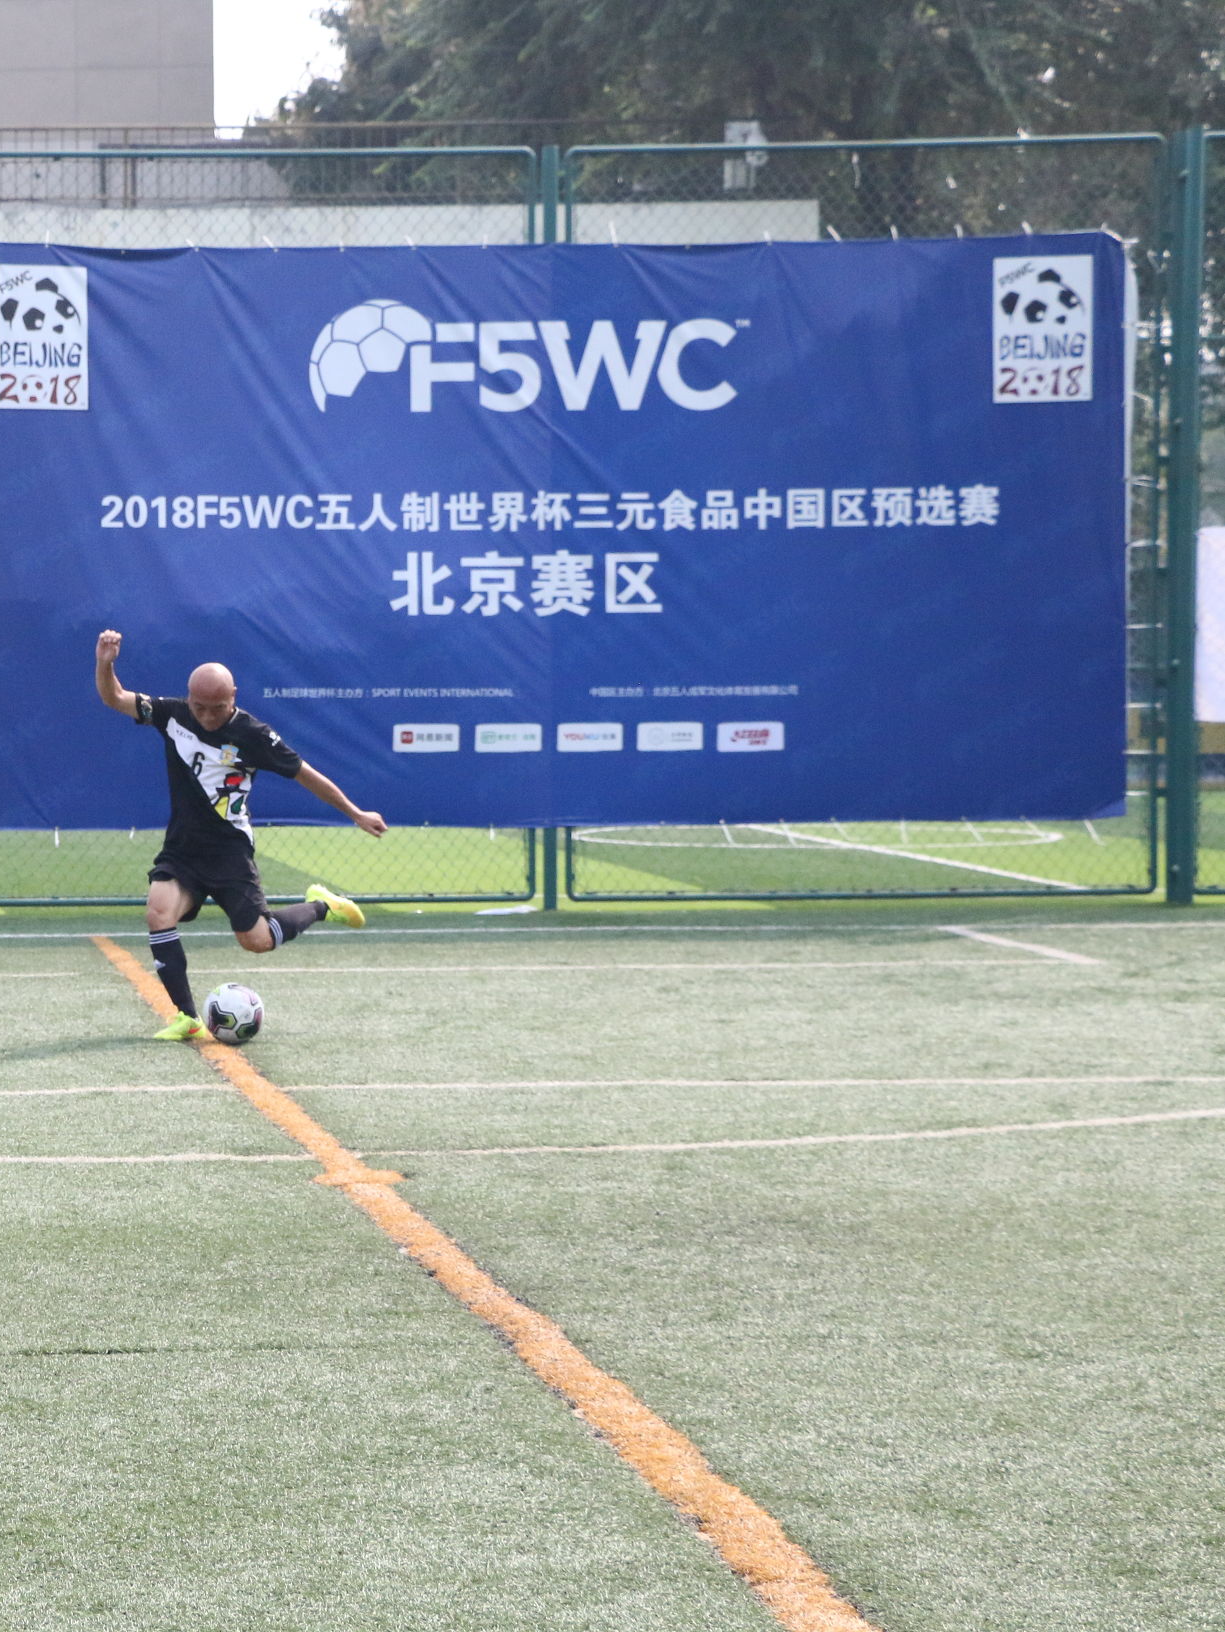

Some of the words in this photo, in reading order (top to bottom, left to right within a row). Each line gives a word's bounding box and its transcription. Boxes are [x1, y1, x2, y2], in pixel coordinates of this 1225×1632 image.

[0, 341, 82, 368] BEIJING
[999, 333, 1086, 360] BEIJING
[410, 319, 738, 412] F5WC
[100, 485, 1000, 532] 2018F5WC五人制世界杯三元食品中国区预选赛
[388, 551, 664, 617] 北京赛区
[371, 687, 401, 698] SPORT
[403, 687, 438, 698] EVENTS
[440, 687, 514, 698] INTERNATIONAL
[190, 751, 206, 777] 6
